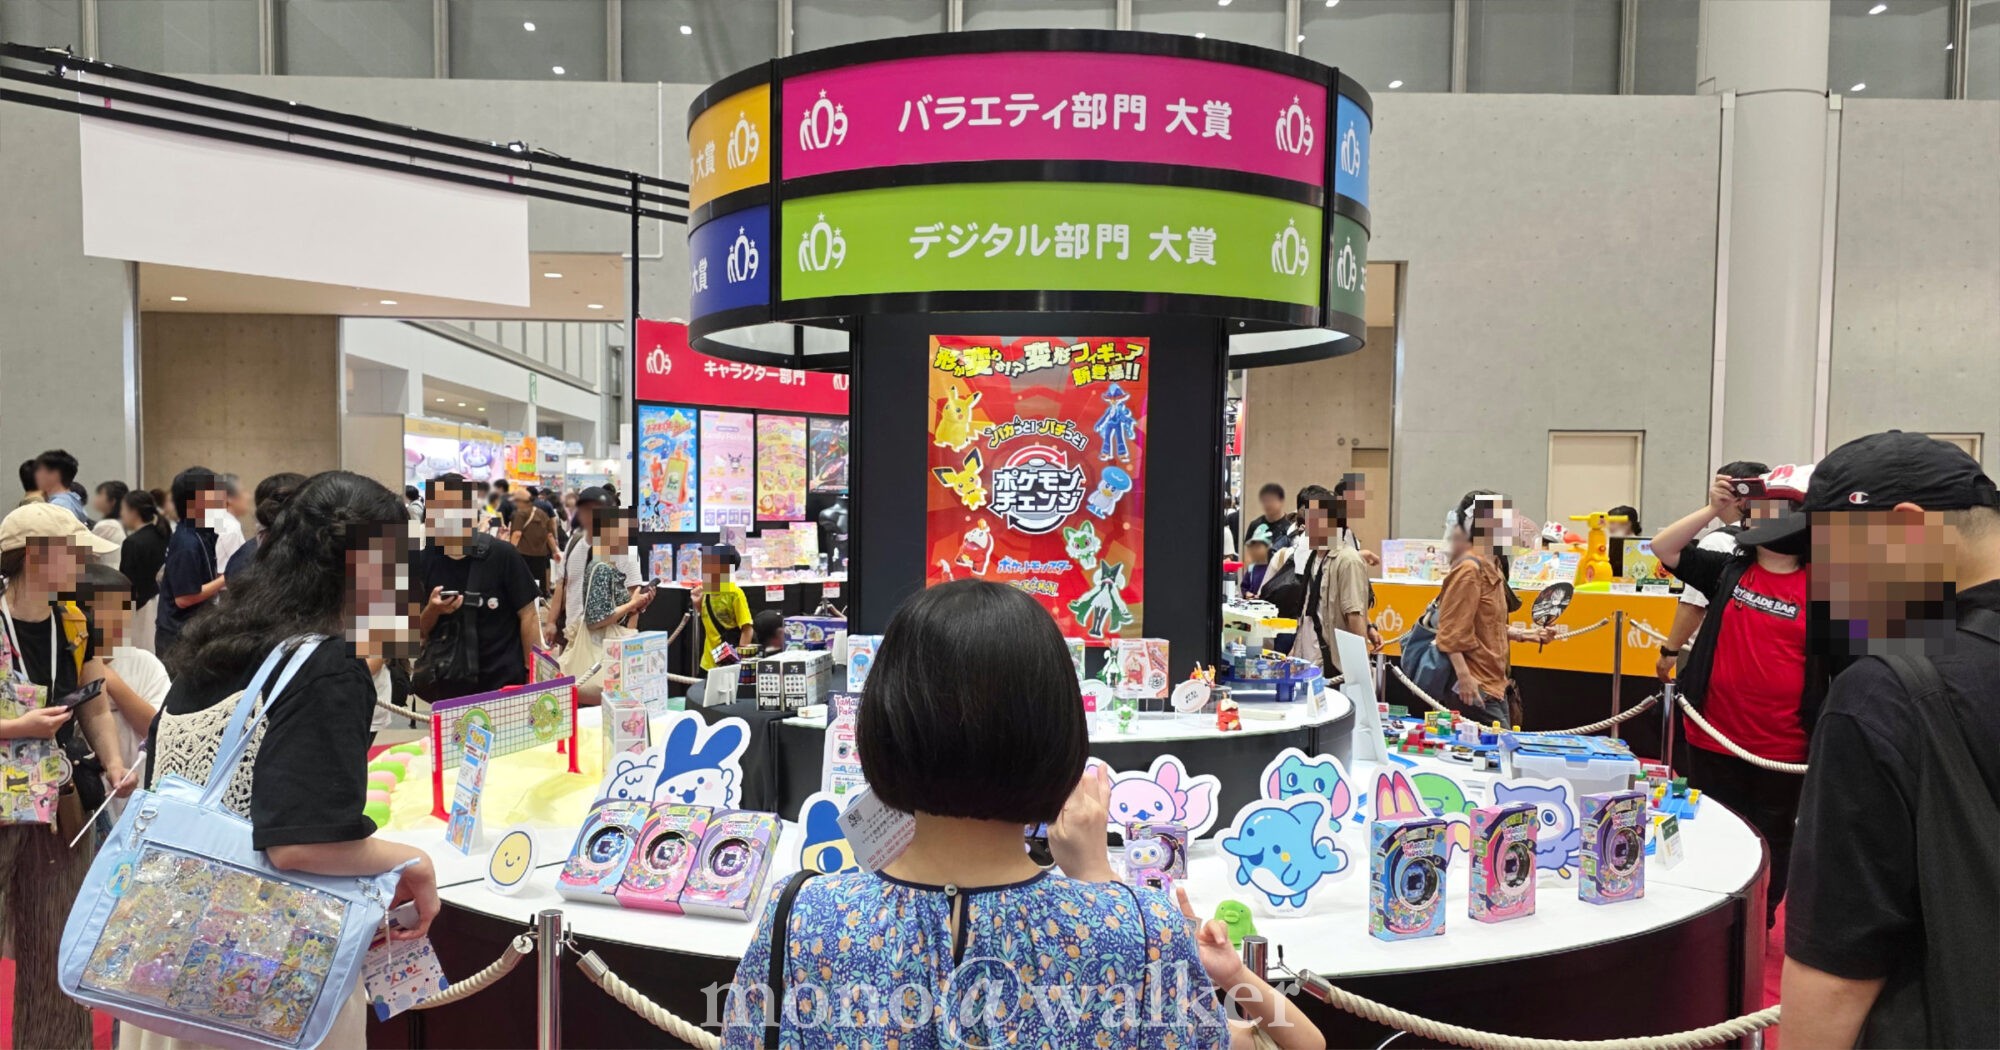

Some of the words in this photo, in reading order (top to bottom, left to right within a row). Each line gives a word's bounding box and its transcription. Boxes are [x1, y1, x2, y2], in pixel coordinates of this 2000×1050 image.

[898, 92, 1147, 134] バラエティ部門
[1165, 98, 1233, 141] 大賞
[696, 140, 716, 182] 大賞
[908, 219, 1129, 262] デジタル部門
[1148, 225, 1217, 266] 大賞
[691, 256, 708, 296] 大賞
[704, 360, 806, 386] キャラクター部門
[995, 469, 1081, 491] ポケモン
[992, 491, 1081, 511] チェンジ
[1773, 601, 1797, 615] BAR
